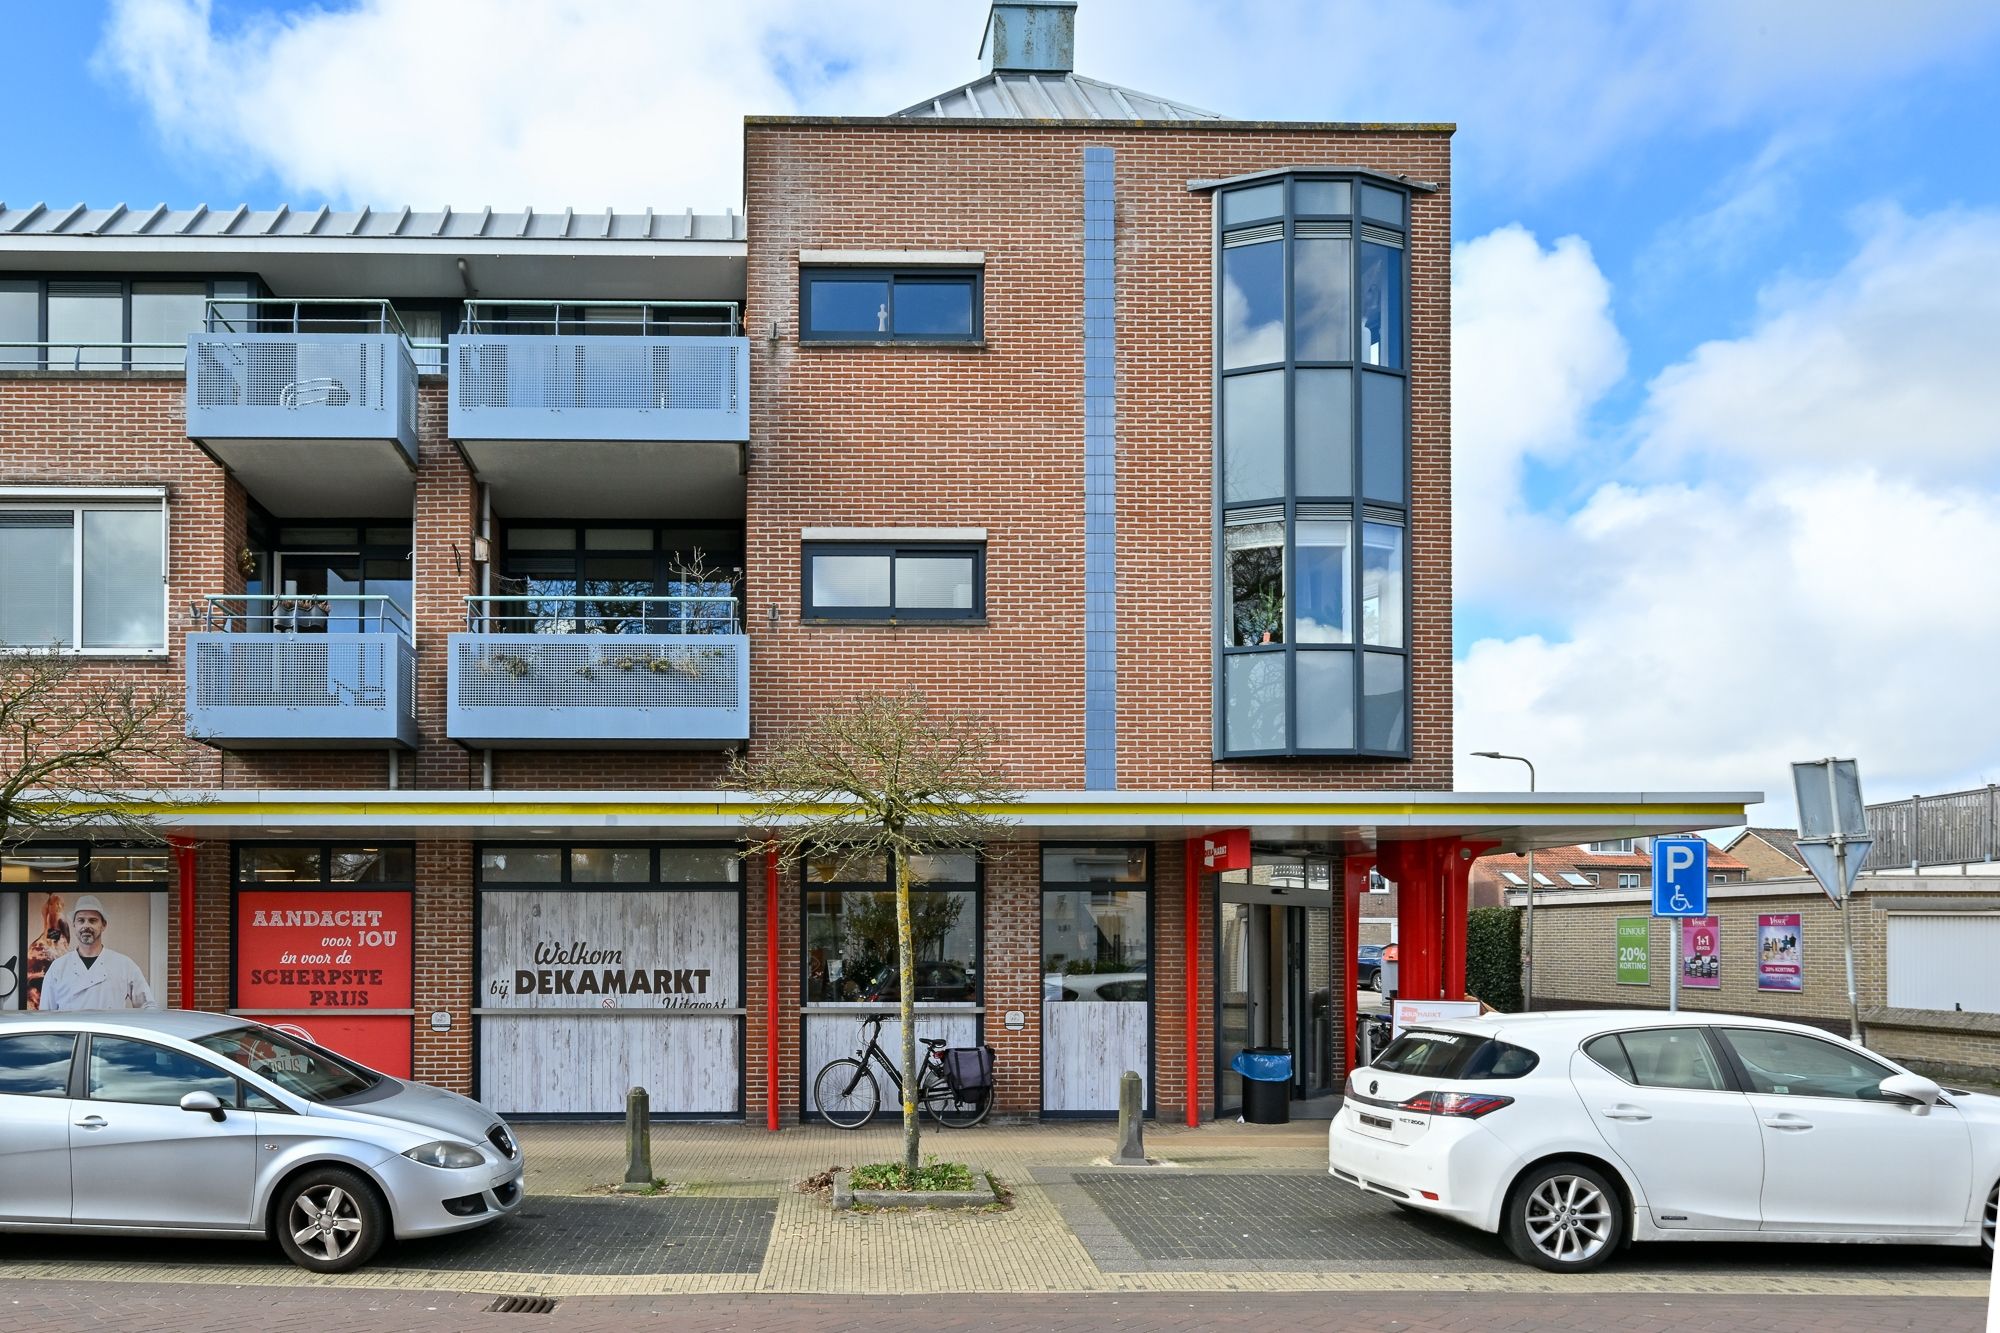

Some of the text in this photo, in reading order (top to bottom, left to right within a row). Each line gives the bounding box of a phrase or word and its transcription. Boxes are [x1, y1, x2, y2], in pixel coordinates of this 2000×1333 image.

[1667, 846, 1694, 883] P
[252, 910, 383, 927] AANDACHT
[321, 930, 398, 947] voor JOU
[1619, 927, 1646, 936] CLINIQUE
[1696, 935, 1709, 946] 1+1
[280, 950, 352, 964] én voor de
[534, 941, 622, 965] Welkom
[1619, 947, 1647, 961] 20%
[1619, 962, 1647, 970] KORTING
[251, 969, 383, 985] SCHERPSTE
[490, 969, 711, 999] bij DEKAMARKT
[309, 990, 369, 1006] PRIJS
